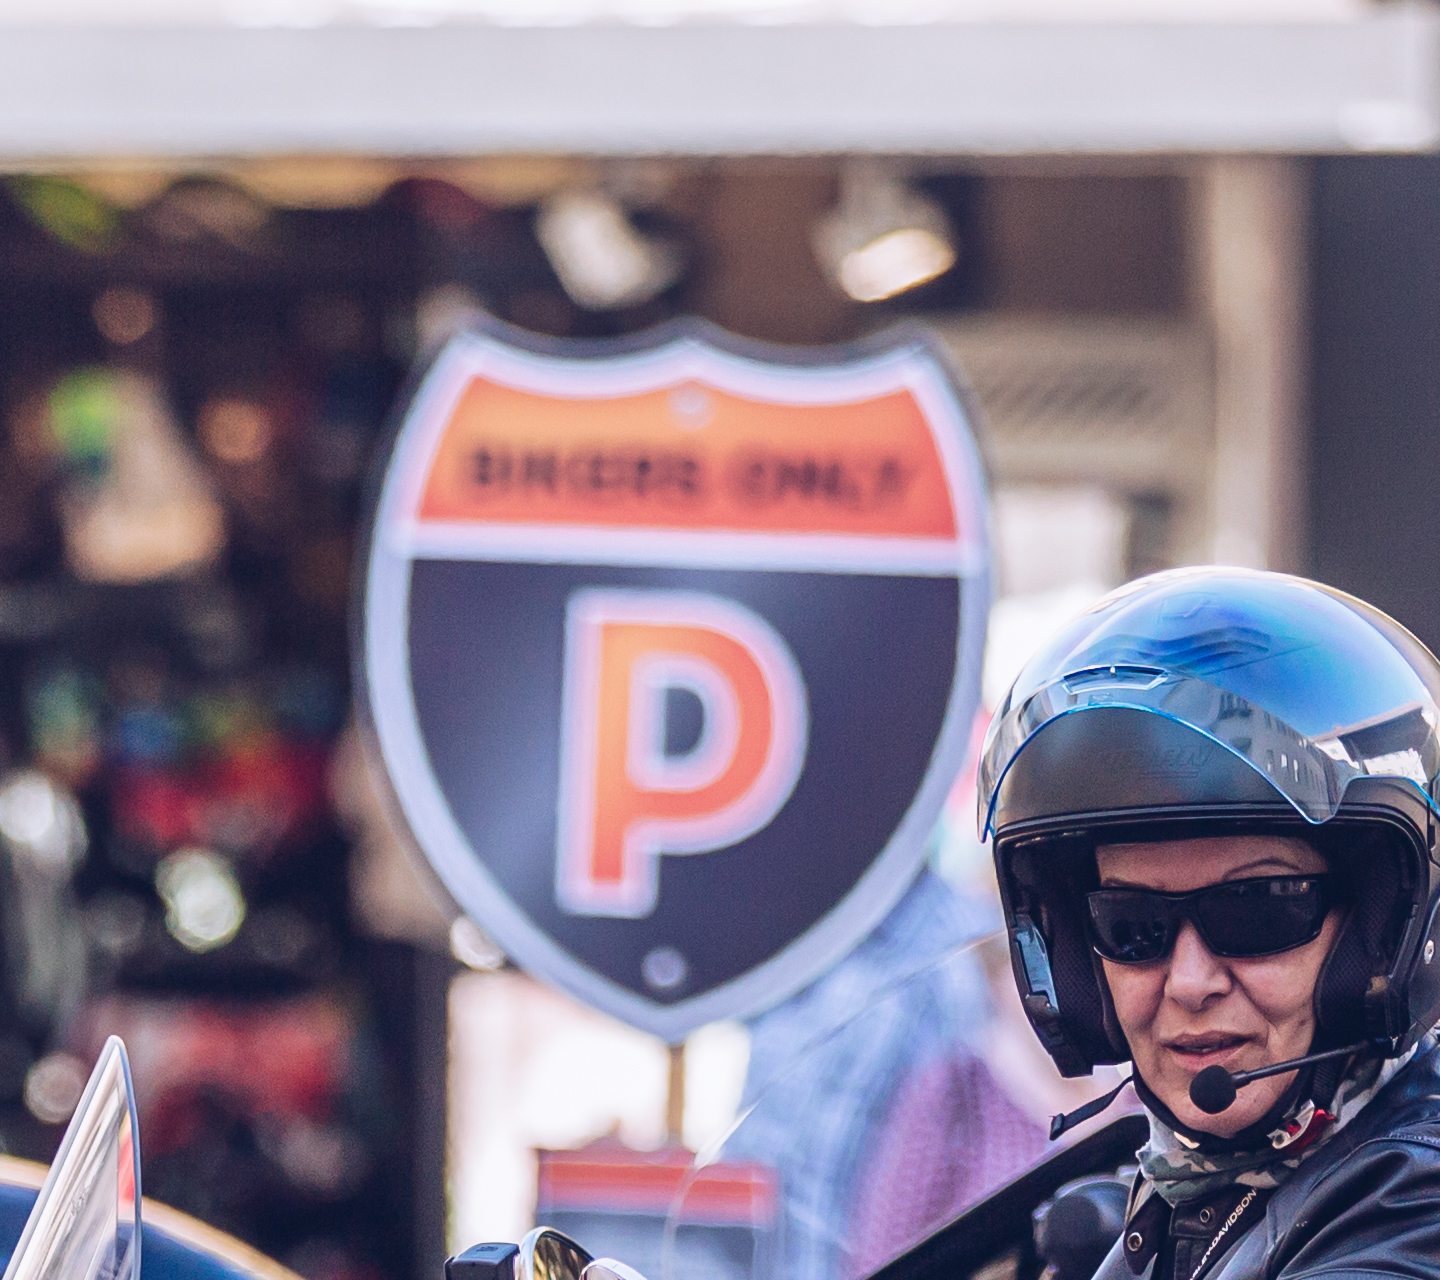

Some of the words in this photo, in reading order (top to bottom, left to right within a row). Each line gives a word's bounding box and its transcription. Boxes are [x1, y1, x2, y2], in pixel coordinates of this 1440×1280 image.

[462, 443, 701, 503] BIKERS
[732, 446, 916, 512] ONLY
[557, 587, 808, 917] P
